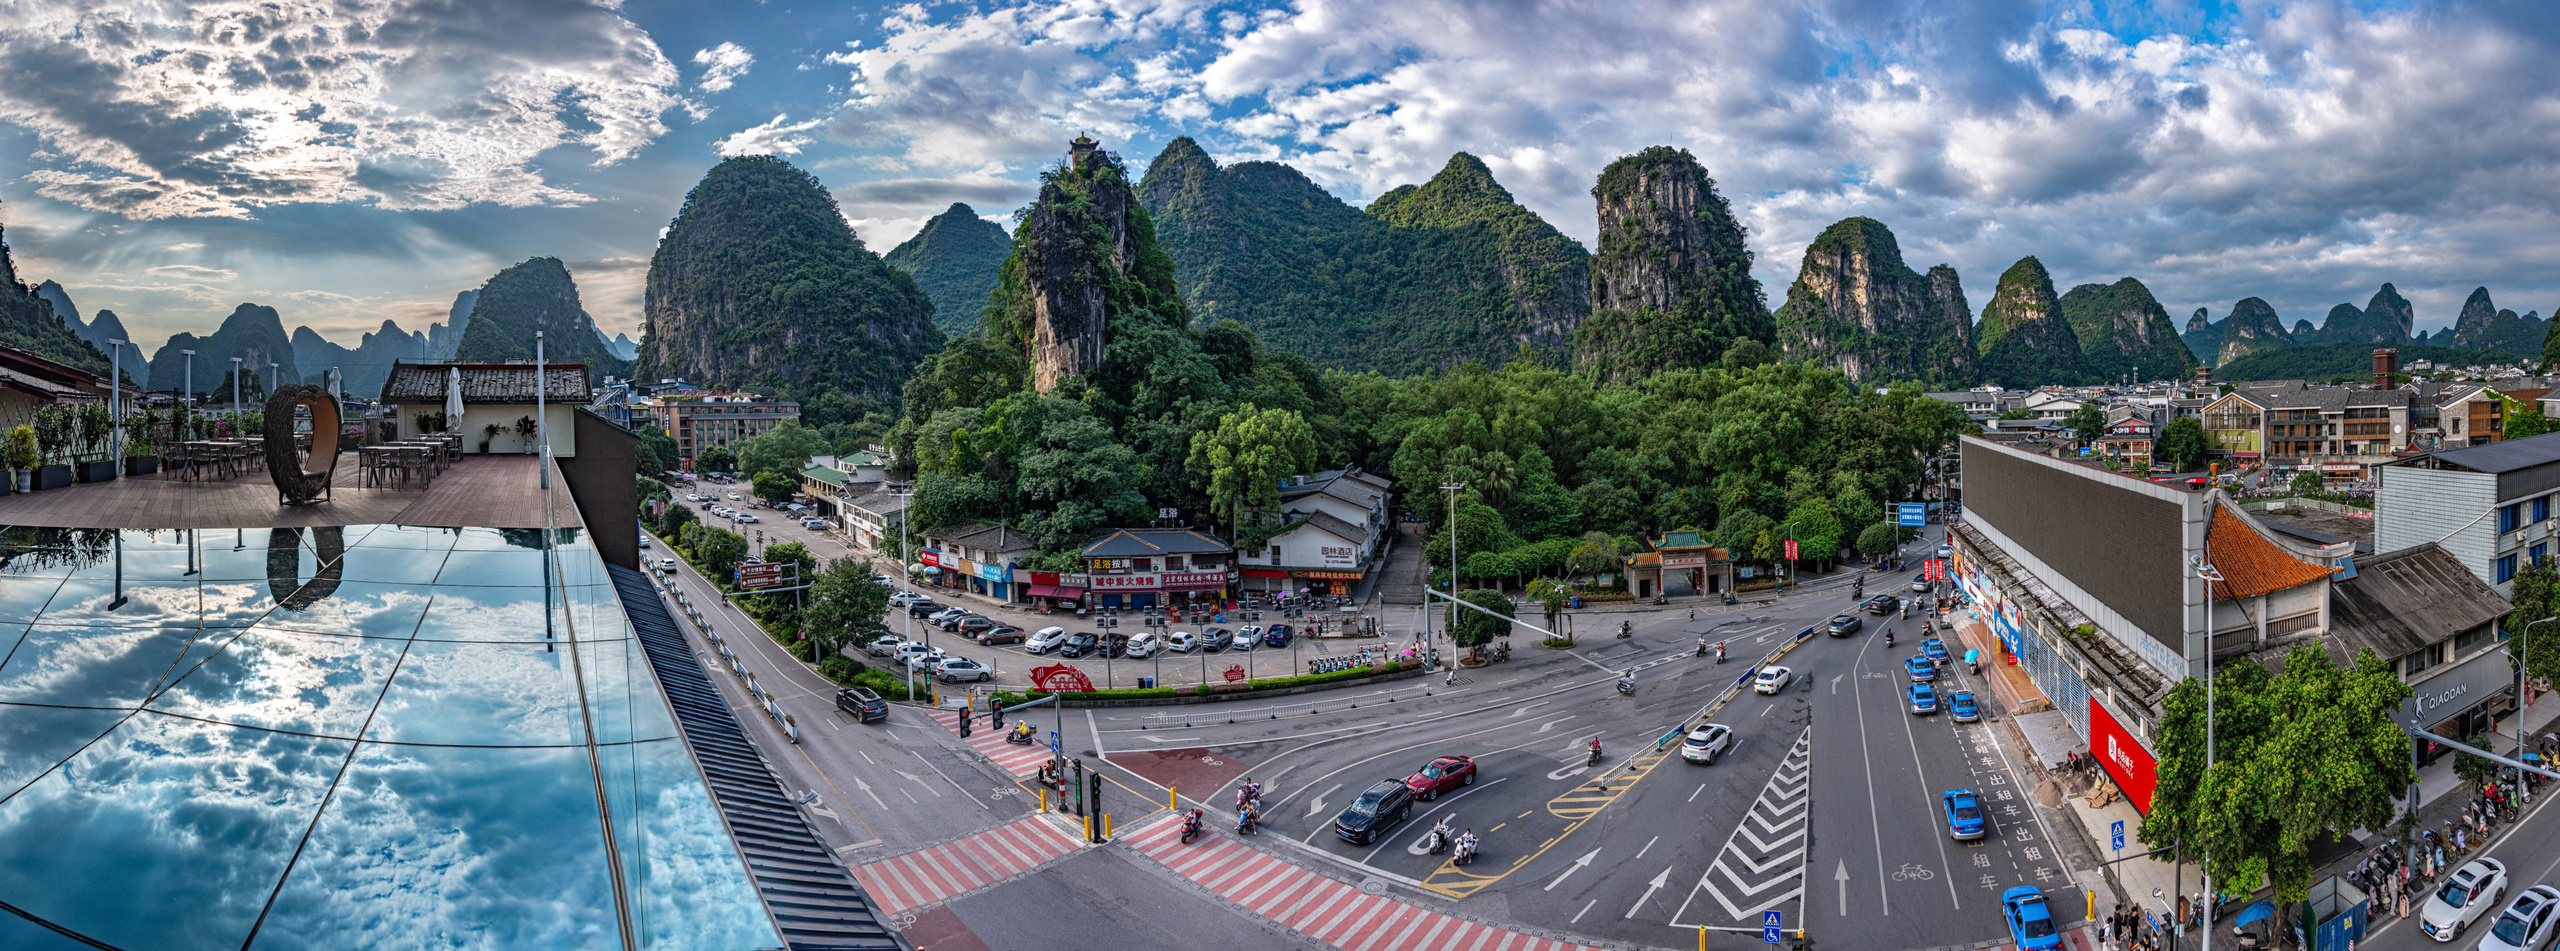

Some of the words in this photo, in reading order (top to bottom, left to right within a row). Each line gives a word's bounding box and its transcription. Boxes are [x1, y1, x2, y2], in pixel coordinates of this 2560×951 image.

[1158, 507, 1179, 518] 足浴
[1095, 576, 1154, 586] 城中炭火烧烤
[2428, 682, 2467, 709] QIAODAN
